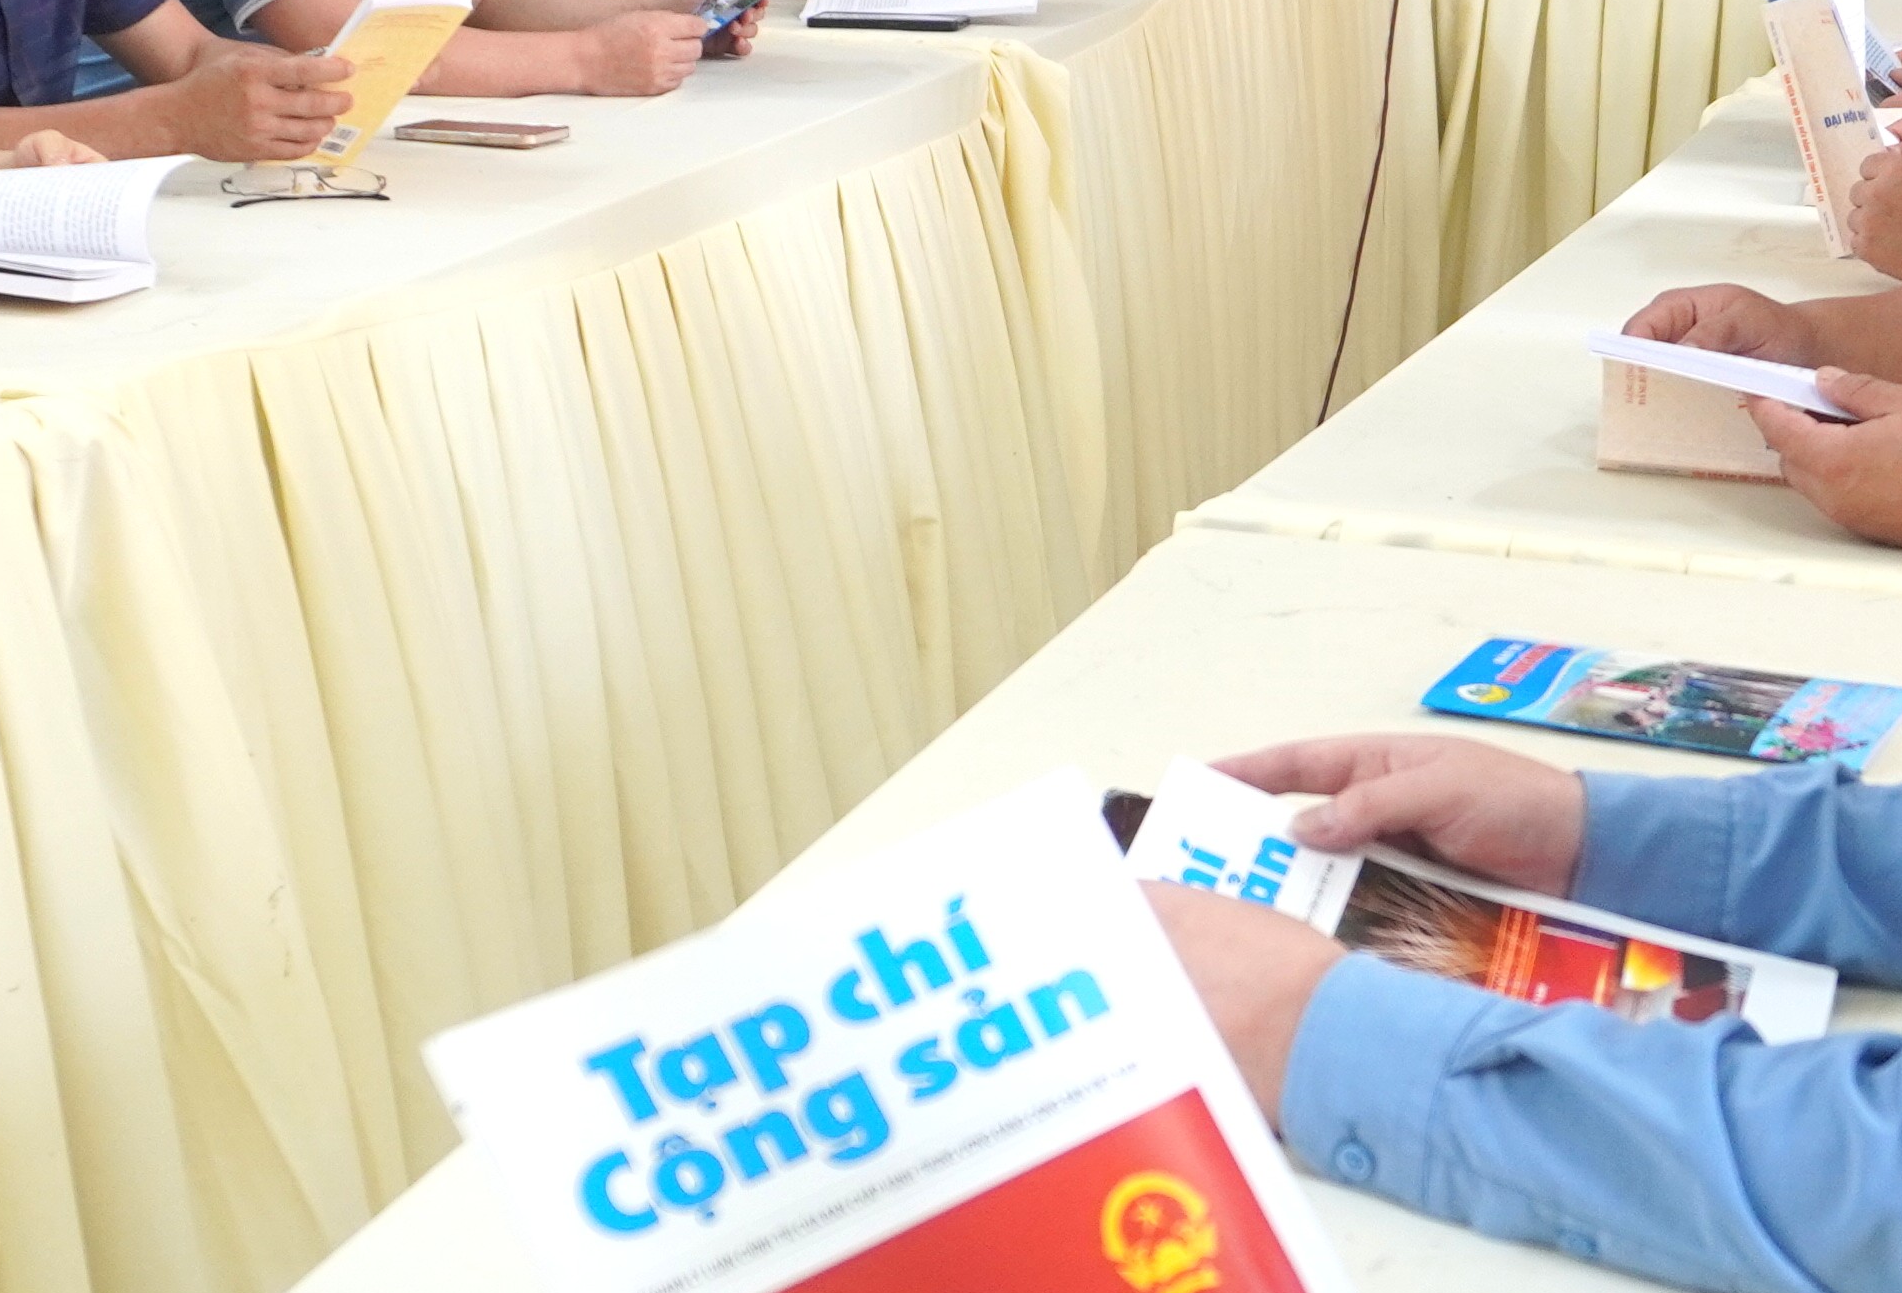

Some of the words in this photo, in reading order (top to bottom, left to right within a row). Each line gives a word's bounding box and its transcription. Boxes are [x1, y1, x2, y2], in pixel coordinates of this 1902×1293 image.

[576, 1065, 894, 1238] Cộng
[897, 965, 1111, 1103] sản
[582, 993, 813, 1126] Tạp
[823, 895, 995, 1028] chí
